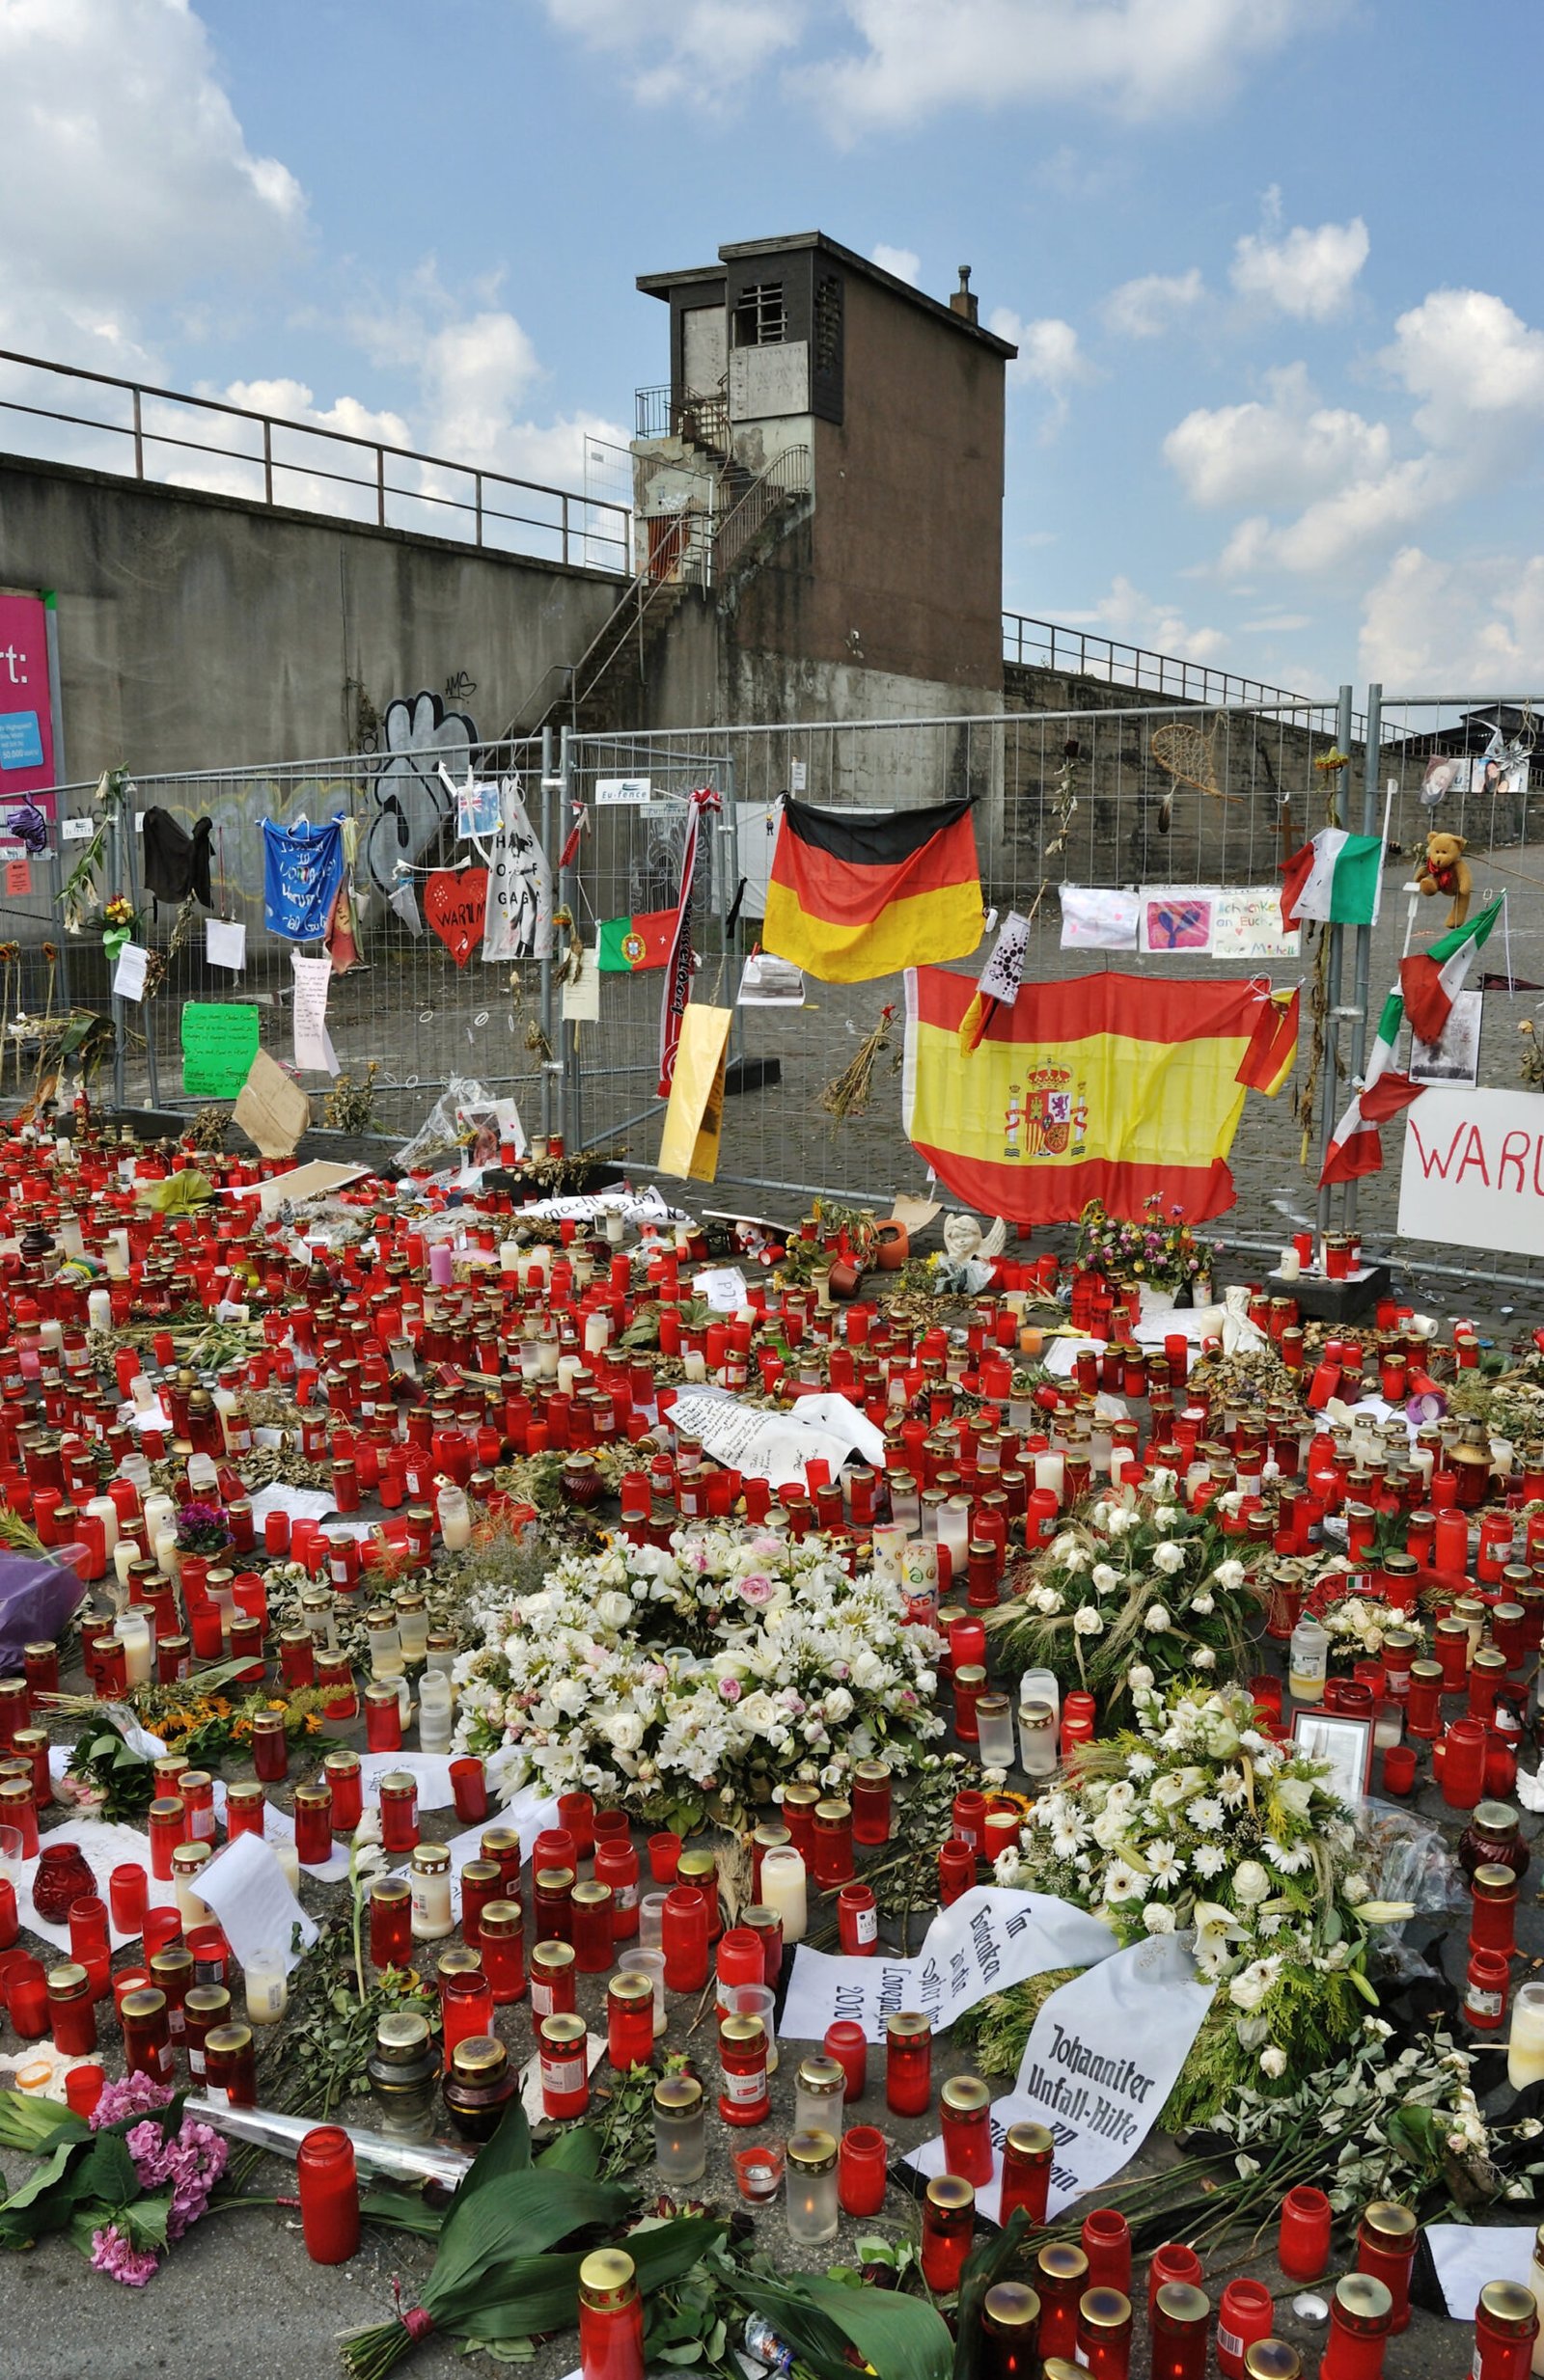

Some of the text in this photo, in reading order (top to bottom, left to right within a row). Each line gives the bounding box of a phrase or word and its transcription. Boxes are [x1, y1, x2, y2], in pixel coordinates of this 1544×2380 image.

[0, 644, 28, 683] t:
[496, 834, 534, 848] HAS
[834, 1985, 865, 2020] 2010
[1048, 2024, 1156, 2104] Johanniter
[1027, 2064, 1138, 2146] Unfall-Hilfe
